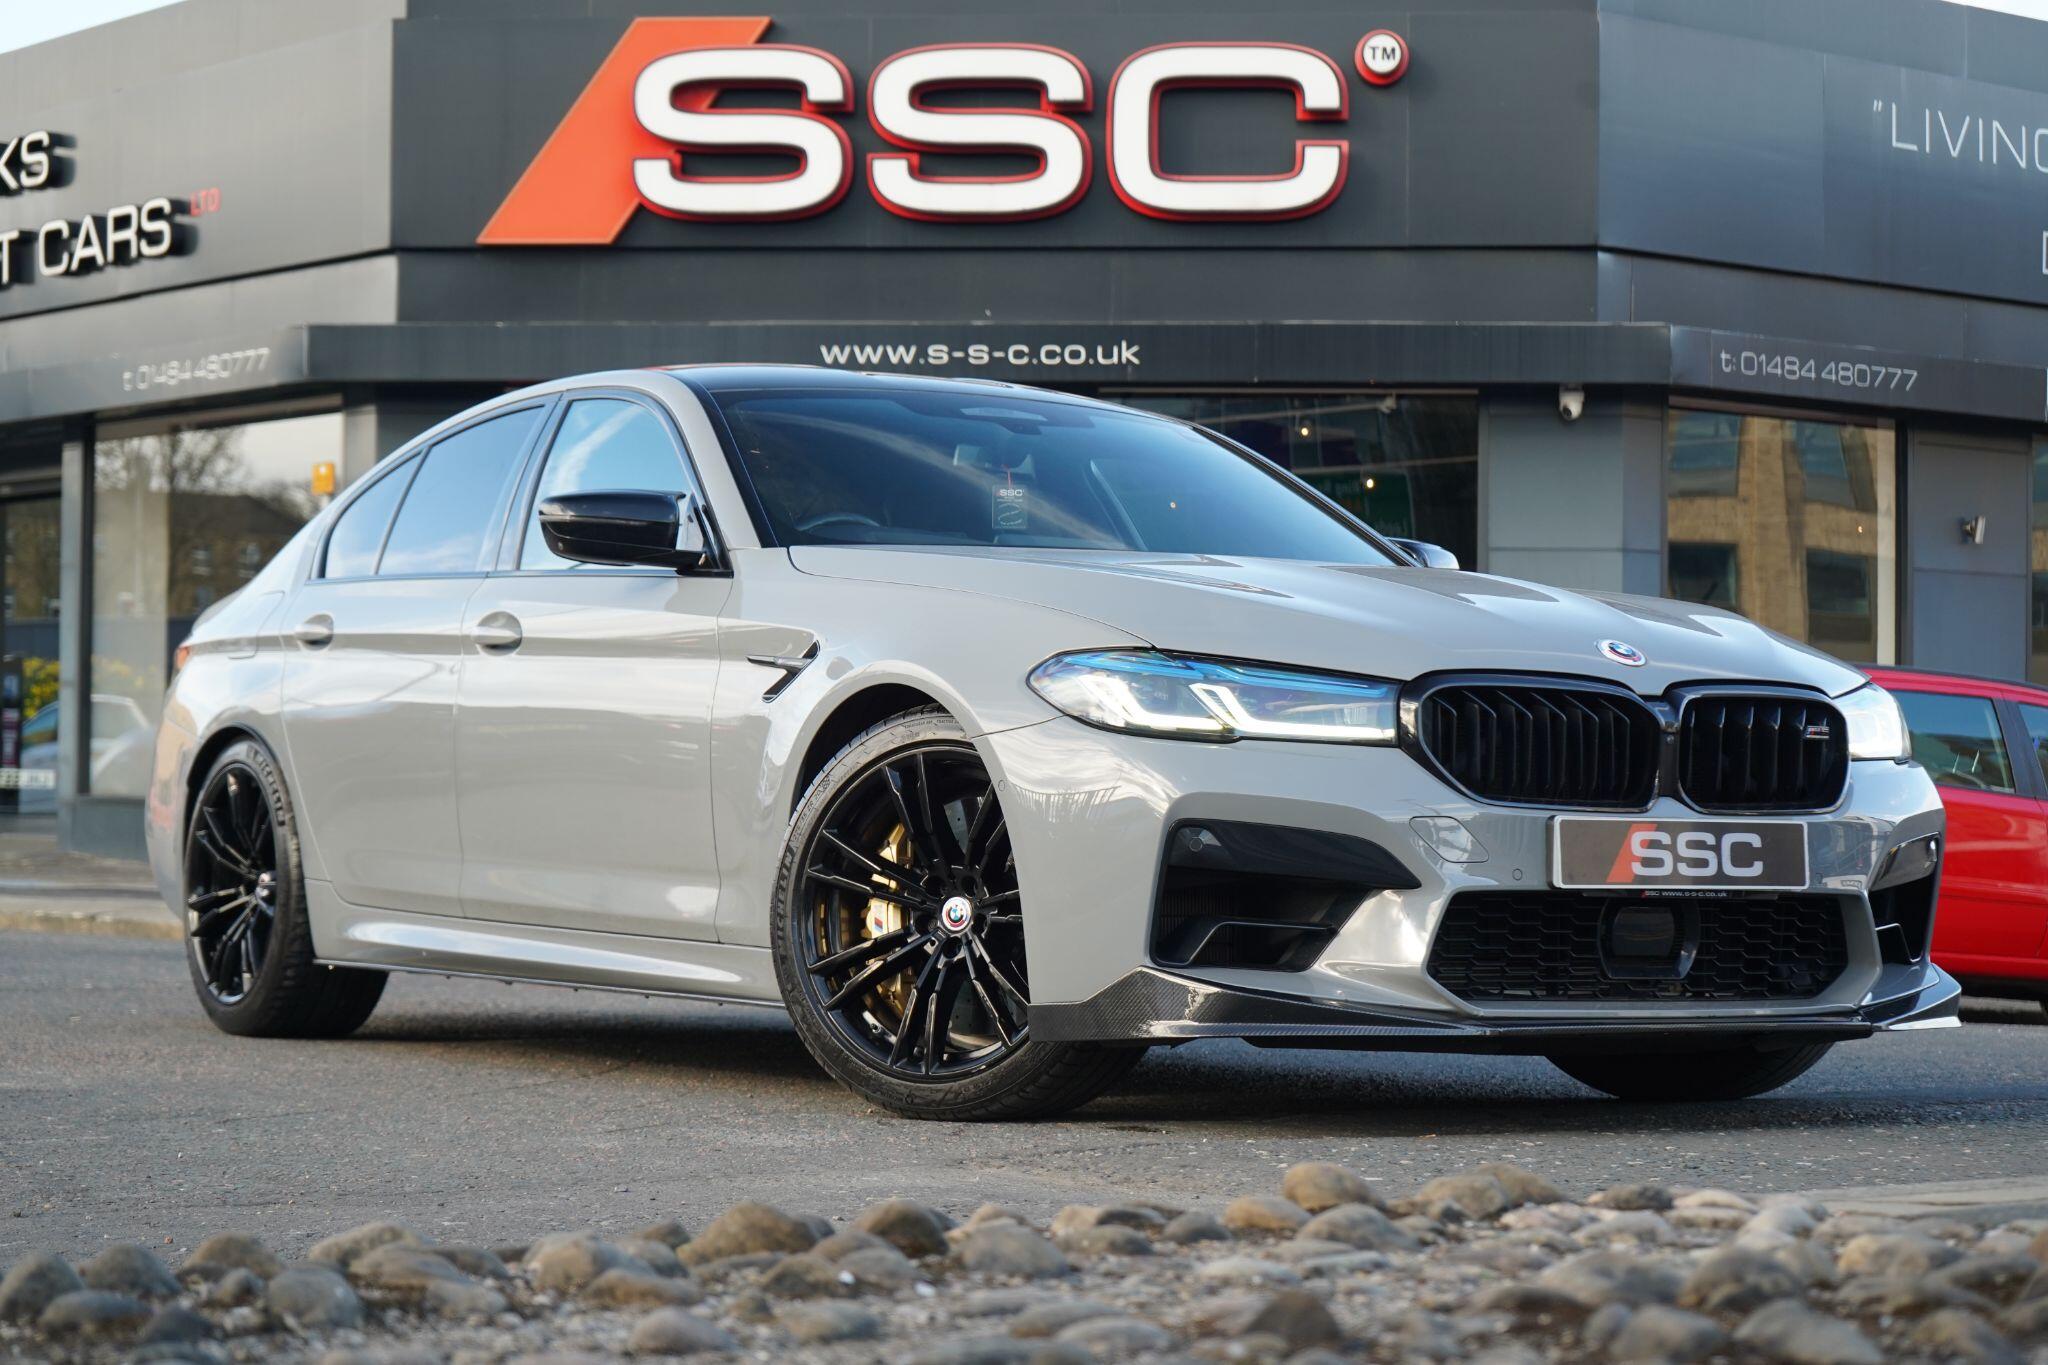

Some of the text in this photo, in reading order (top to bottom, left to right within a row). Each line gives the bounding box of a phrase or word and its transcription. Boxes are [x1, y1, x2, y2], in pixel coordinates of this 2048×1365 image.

[632, 43, 1396, 221] SSC TM
[38, 197, 171, 276] CARS
[190, 187, 220, 217] LTD
[820, 340, 1140, 365] www.s-s-c.co.uk
[1820, 361, 1918, 391] 480777
[1630, 831, 1763, 877] SSC
